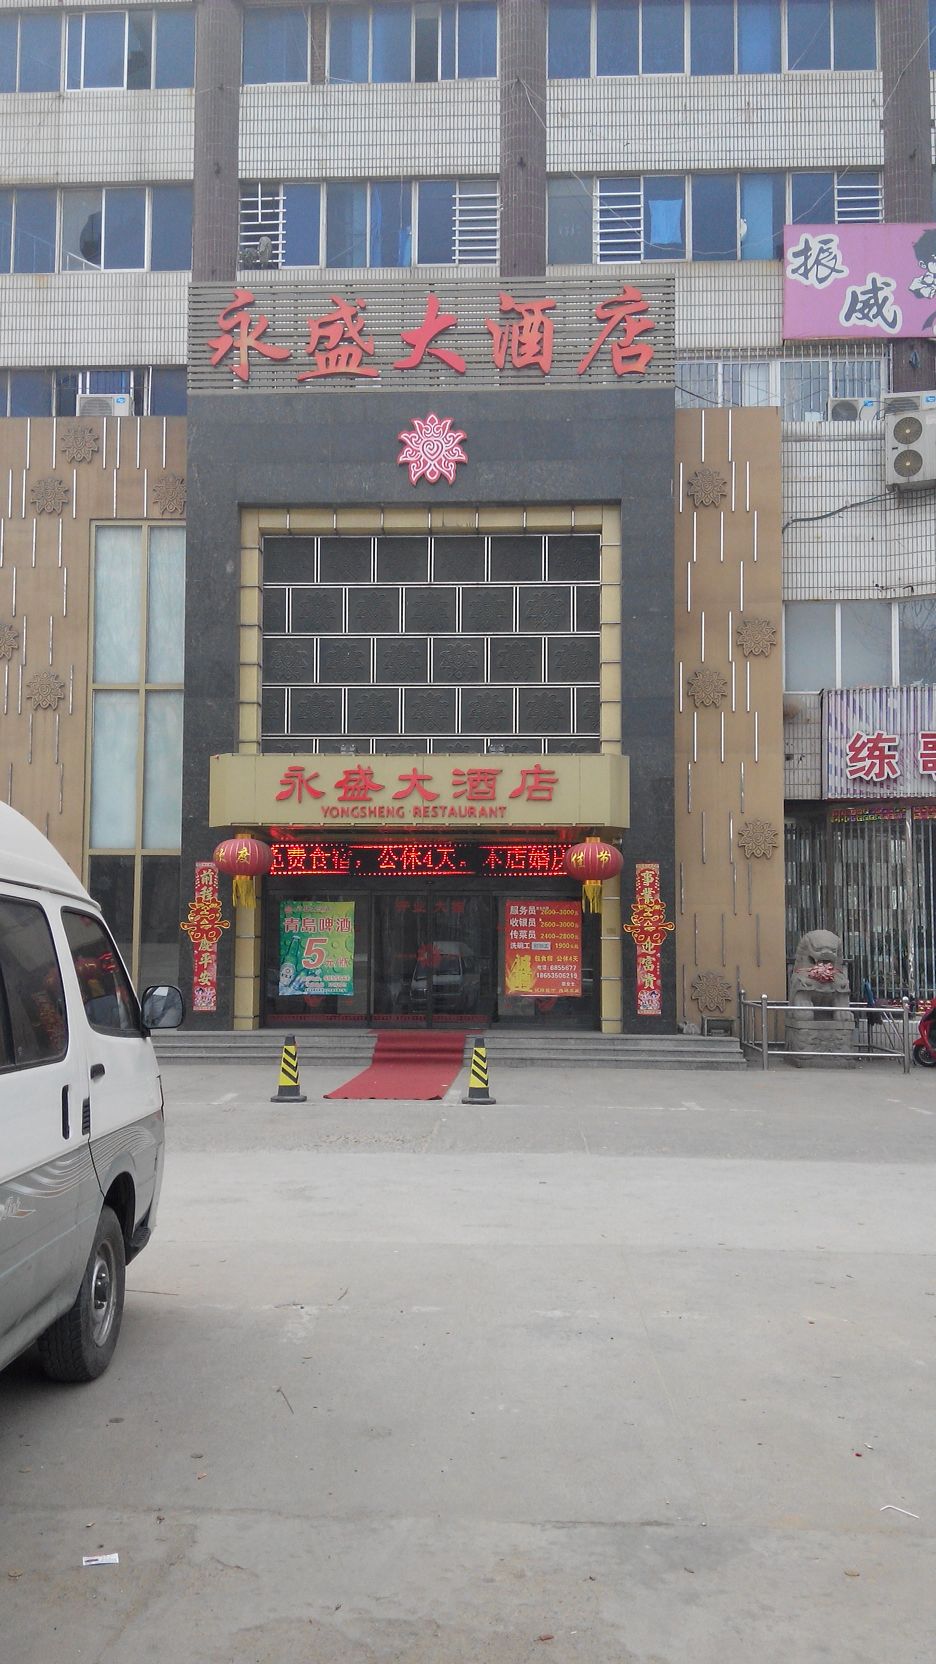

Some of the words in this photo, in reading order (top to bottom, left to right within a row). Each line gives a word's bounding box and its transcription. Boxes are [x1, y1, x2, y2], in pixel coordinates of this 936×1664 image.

[207, 285, 656, 382] 永盛大酒店
[275, 764, 559, 803] 永盛大酒店
[321, 806, 405, 819] YONGSHENG
[412, 806, 507, 819] RESTAURANT
[510, 905, 536, 916] 服务员
[510, 917, 536, 928] 收银员
[510, 929, 536, 940] 传菜员
